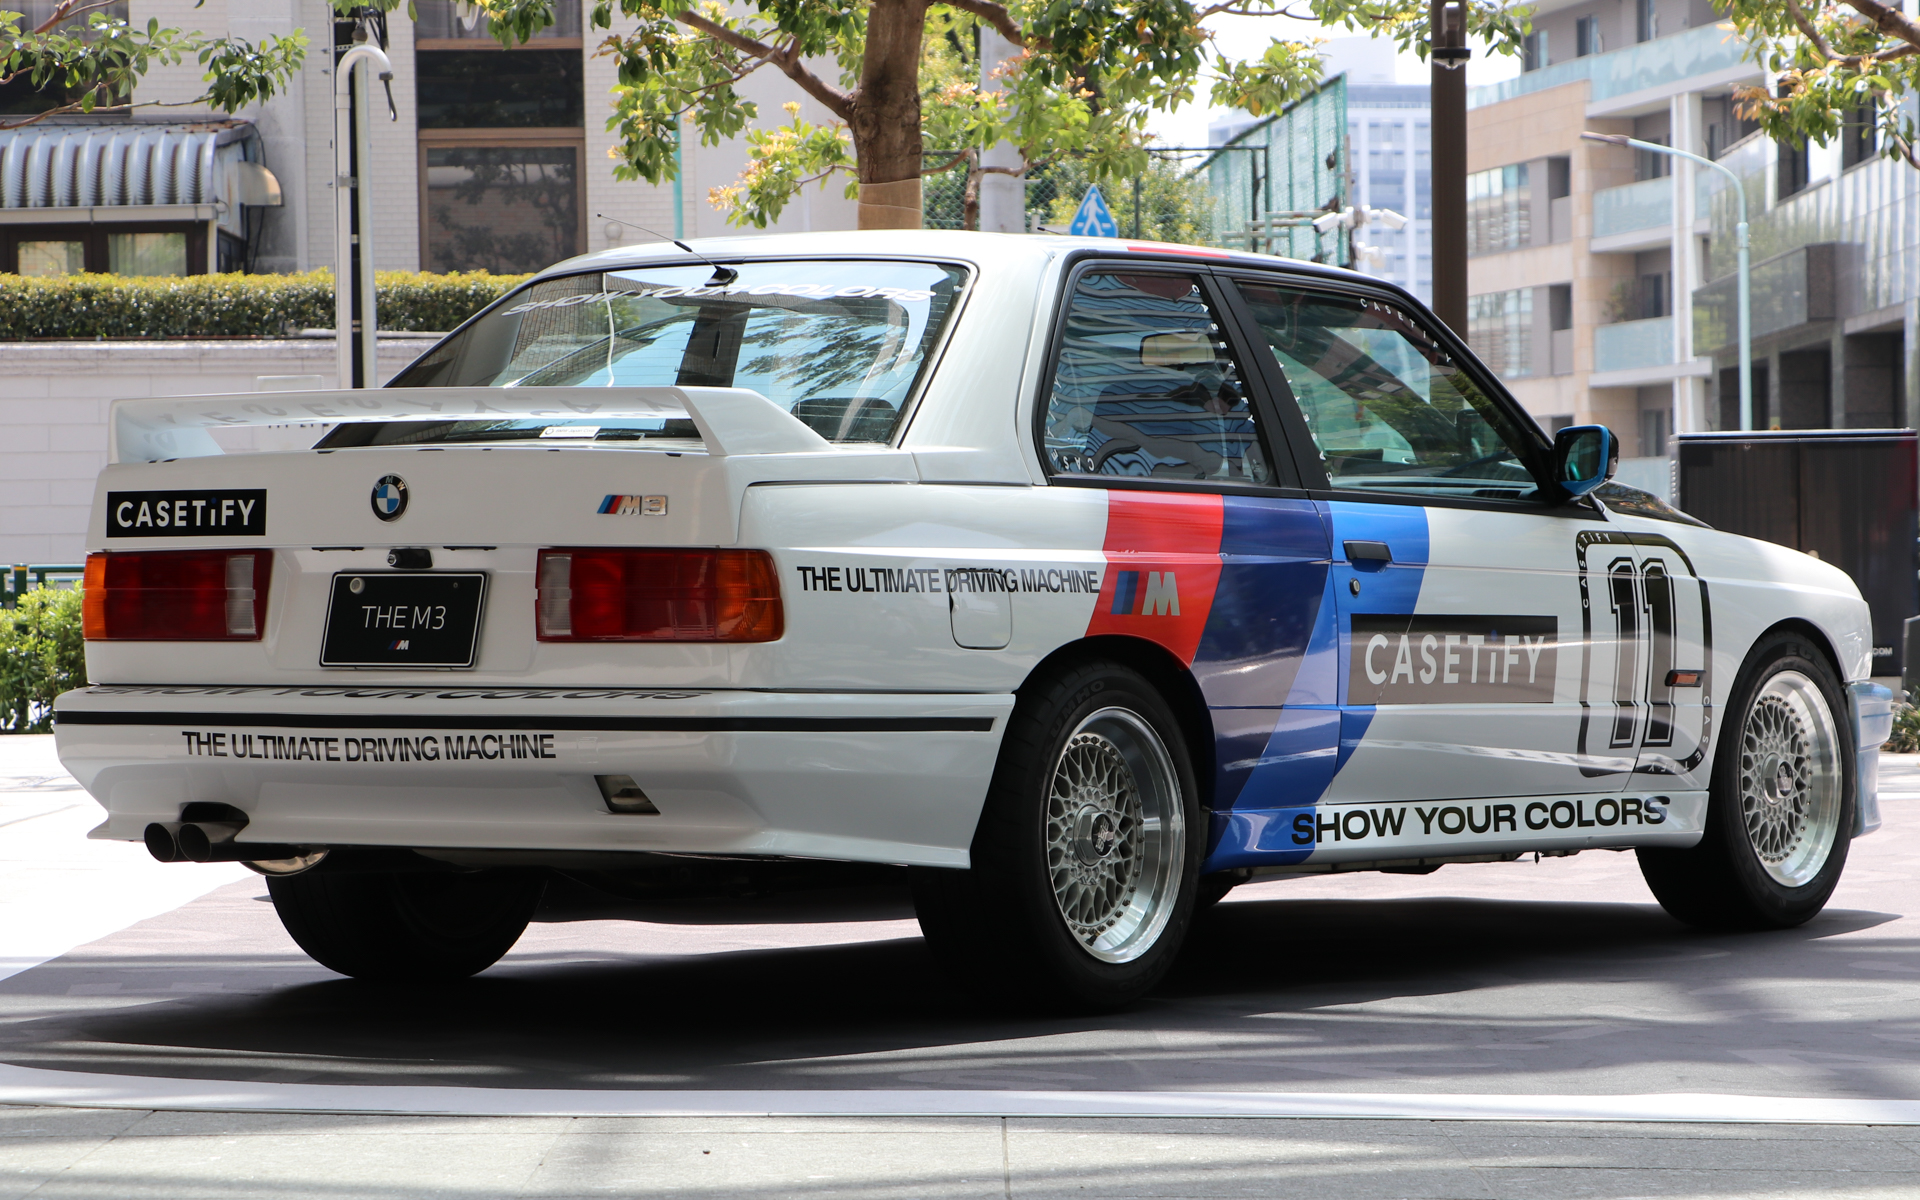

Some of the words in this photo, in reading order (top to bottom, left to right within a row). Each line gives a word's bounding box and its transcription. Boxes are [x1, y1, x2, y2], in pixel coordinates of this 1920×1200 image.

[501, 289, 636, 316] SHOW
[634, 285, 750, 300] YOUR
[748, 283, 937, 301] COLORS
[615, 494, 669, 516] M3
[796, 565, 842, 592] THE
[845, 566, 942, 593] ULTIMATE
[943, 567, 1019, 593] DRIVING
[1021, 568, 1101, 594] MACHINE
[1141, 570, 1181, 616] M
[361, 605, 408, 629] THE
[411, 605, 447, 630] M3
[1607, 556, 1678, 749] 11
[181, 731, 228, 757] THE
[231, 733, 341, 762] ULTIMATE
[344, 735, 440, 762] DRIVING
[443, 733, 557, 760] MACHINE
[1290, 806, 1406, 845] SHOW
[1414, 802, 1516, 835] YOUR
[1524, 795, 1671, 831] COLORS
